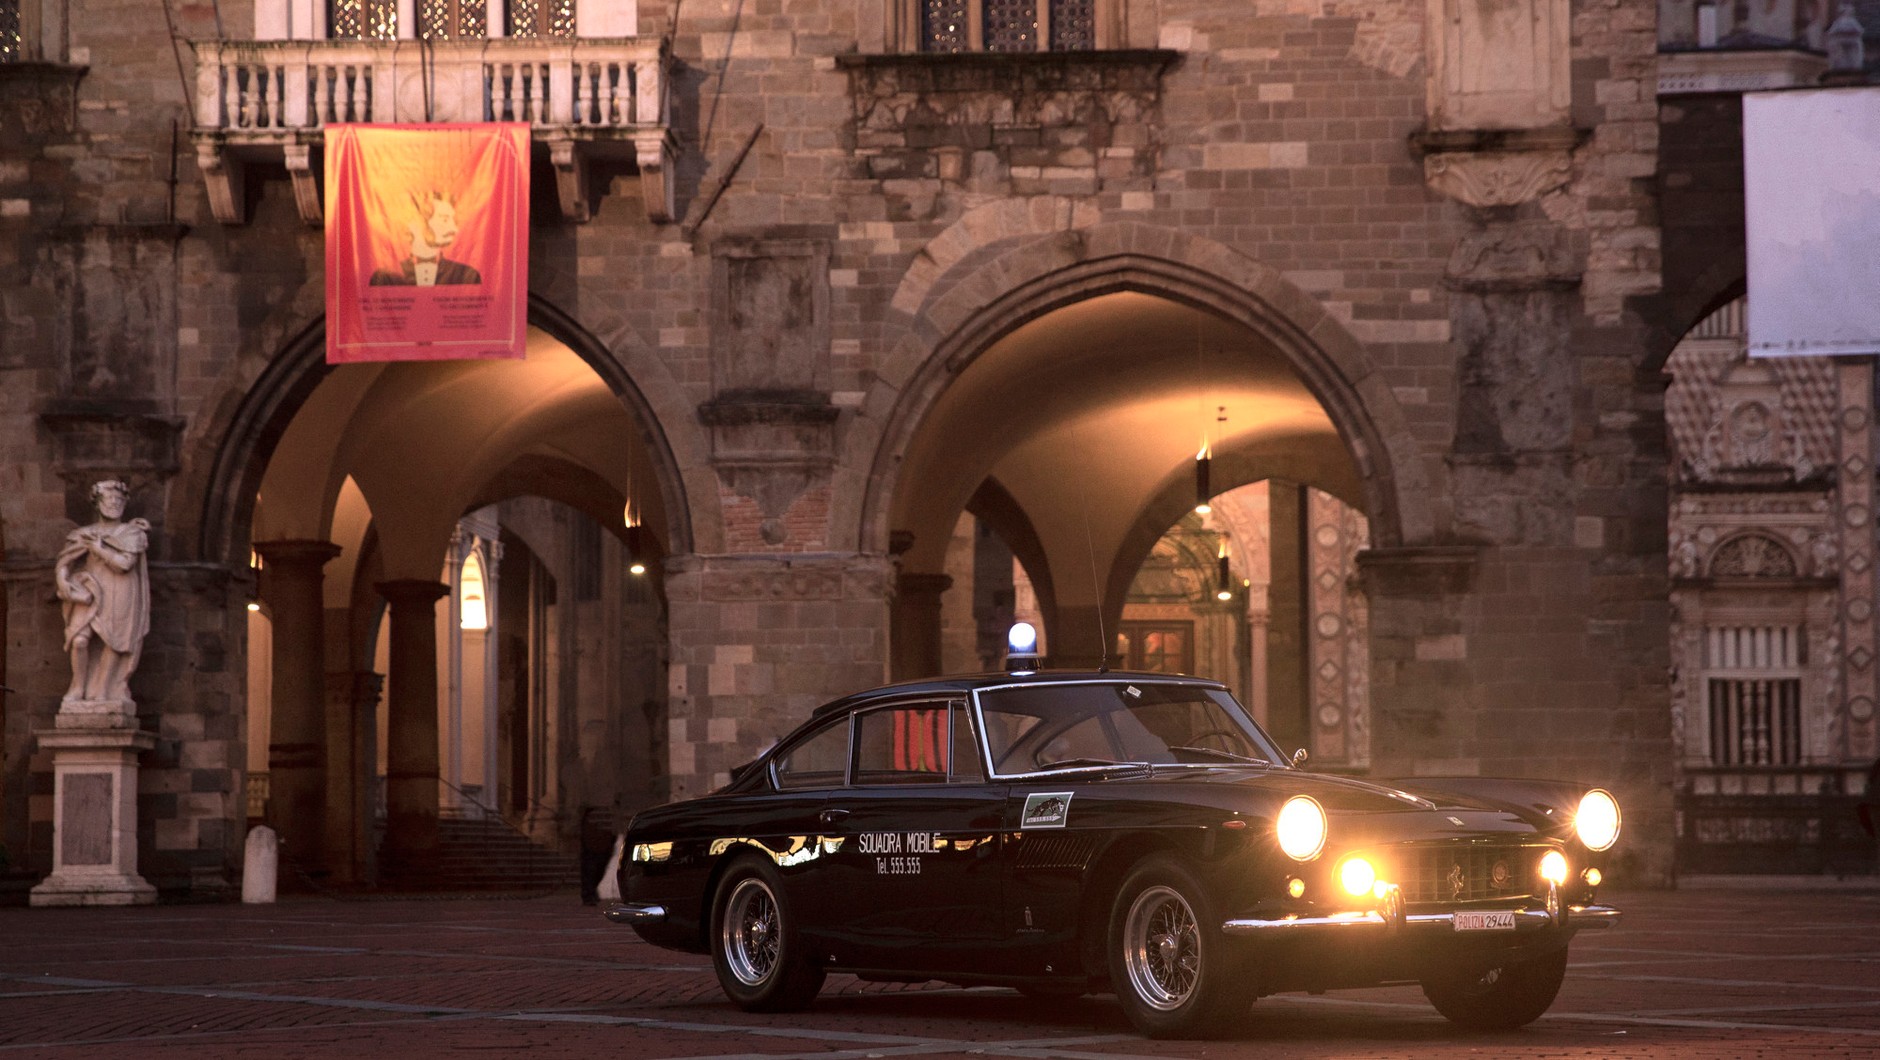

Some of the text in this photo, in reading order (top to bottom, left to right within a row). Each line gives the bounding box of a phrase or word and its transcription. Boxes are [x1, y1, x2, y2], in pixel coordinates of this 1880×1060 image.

[858, 832, 941, 853] SQUADRA MOBILE
[876, 857, 921, 874] Tel. 555.555
[1458, 914, 1513, 928] POLIZIA 29444
